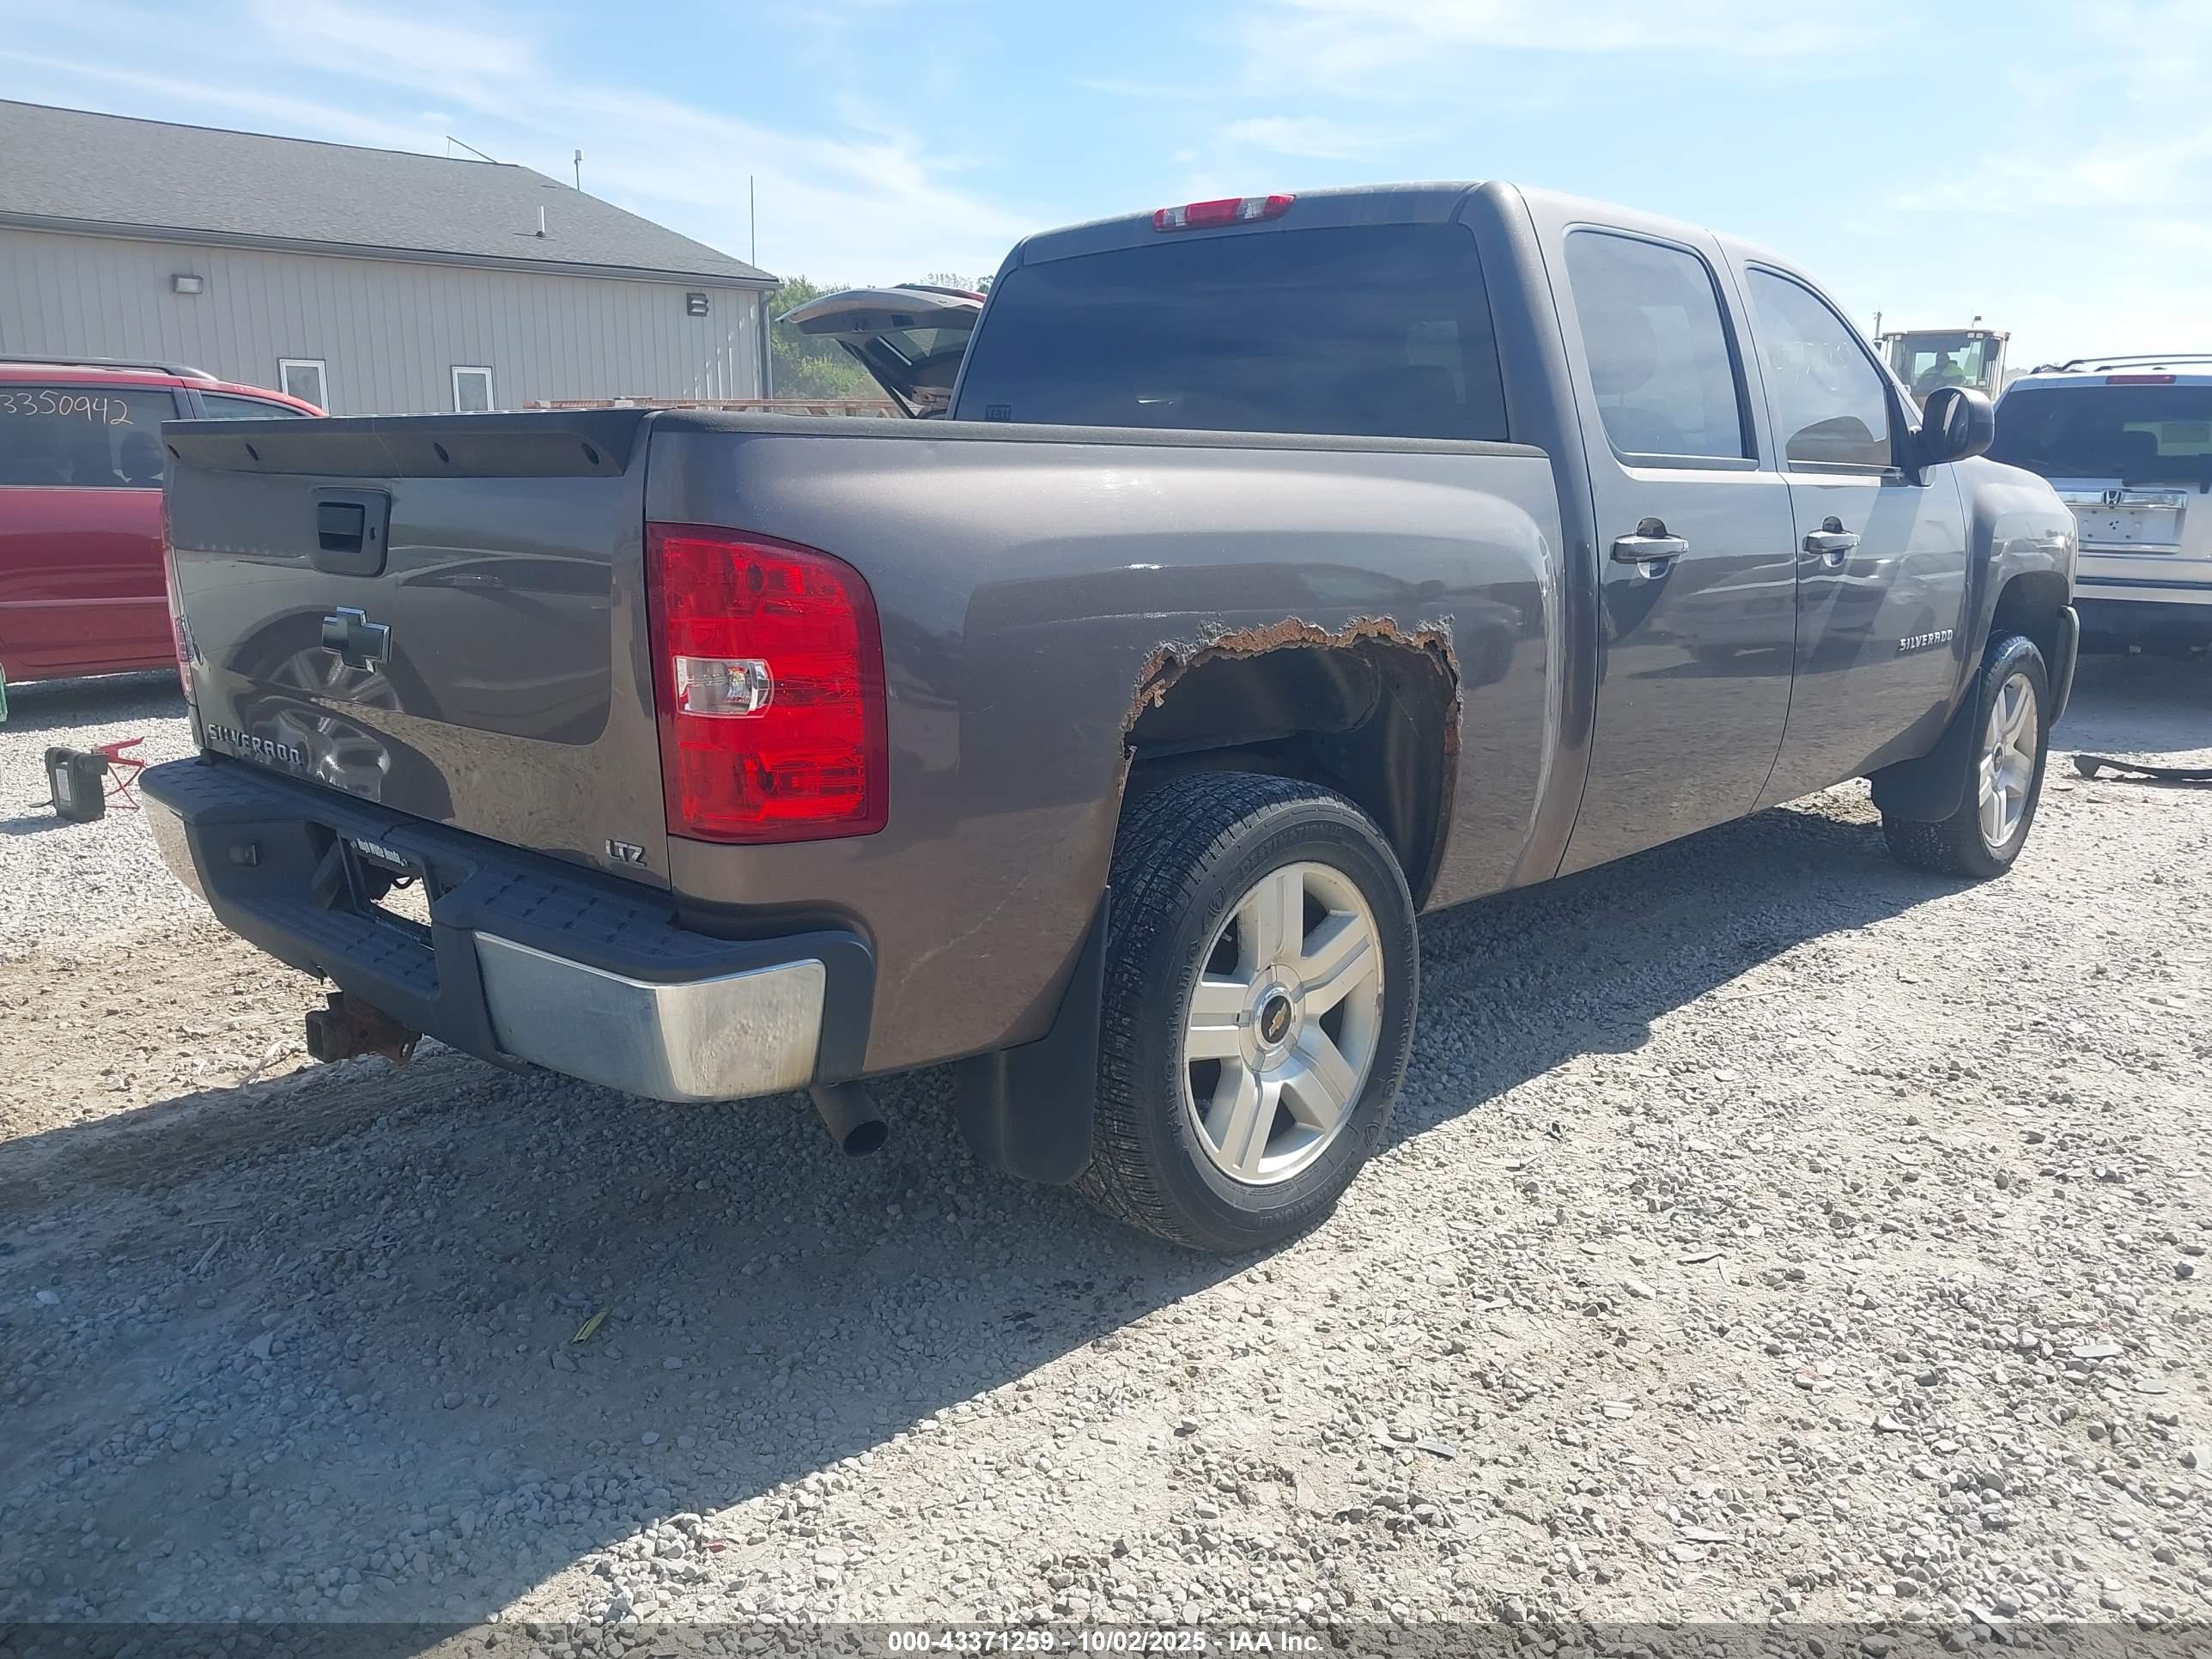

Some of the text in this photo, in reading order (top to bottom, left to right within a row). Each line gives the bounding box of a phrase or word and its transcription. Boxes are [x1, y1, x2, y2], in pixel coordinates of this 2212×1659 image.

[988, 405, 1010, 419] YETI
[1899, 629, 1954, 652] SILVERADO
[208, 723, 302, 765] SILVERADO
[605, 839, 647, 866] LTZ
